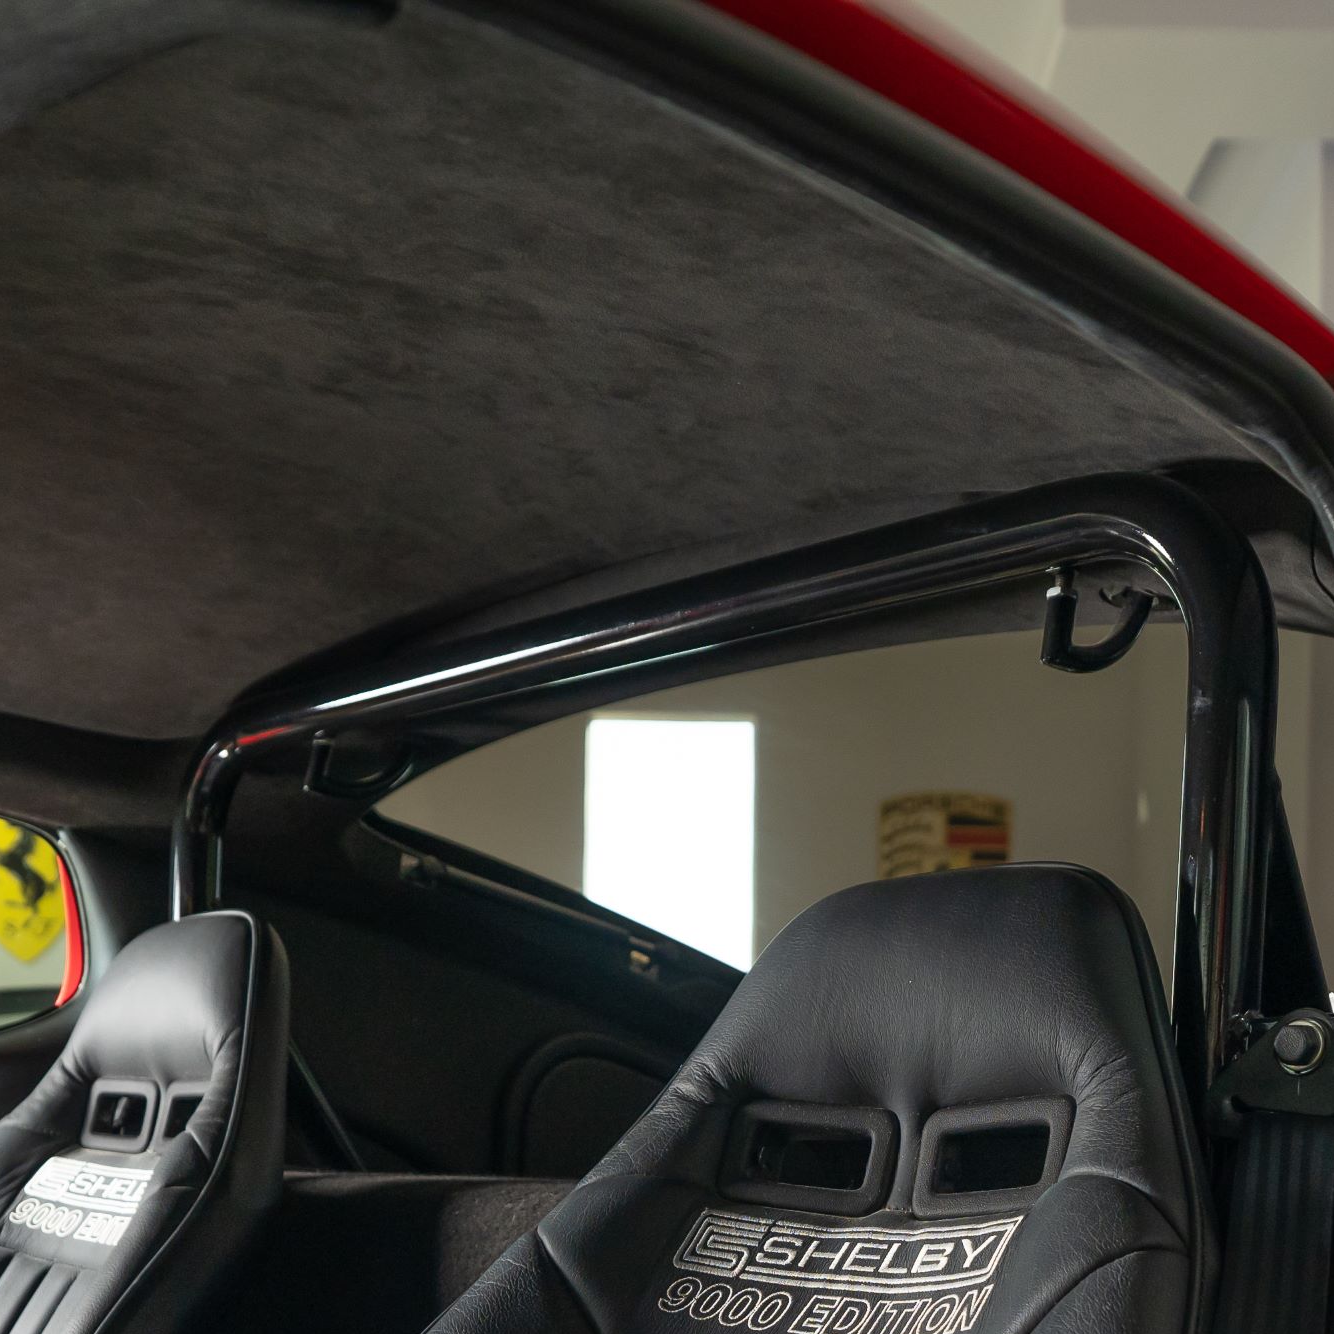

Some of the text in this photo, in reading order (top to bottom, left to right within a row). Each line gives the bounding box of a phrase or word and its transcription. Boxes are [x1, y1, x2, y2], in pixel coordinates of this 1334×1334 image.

[9, 1198, 83, 1237] 9000
[755, 1235, 997, 1274] SHELBY
[658, 1276, 792, 1331] 9000
